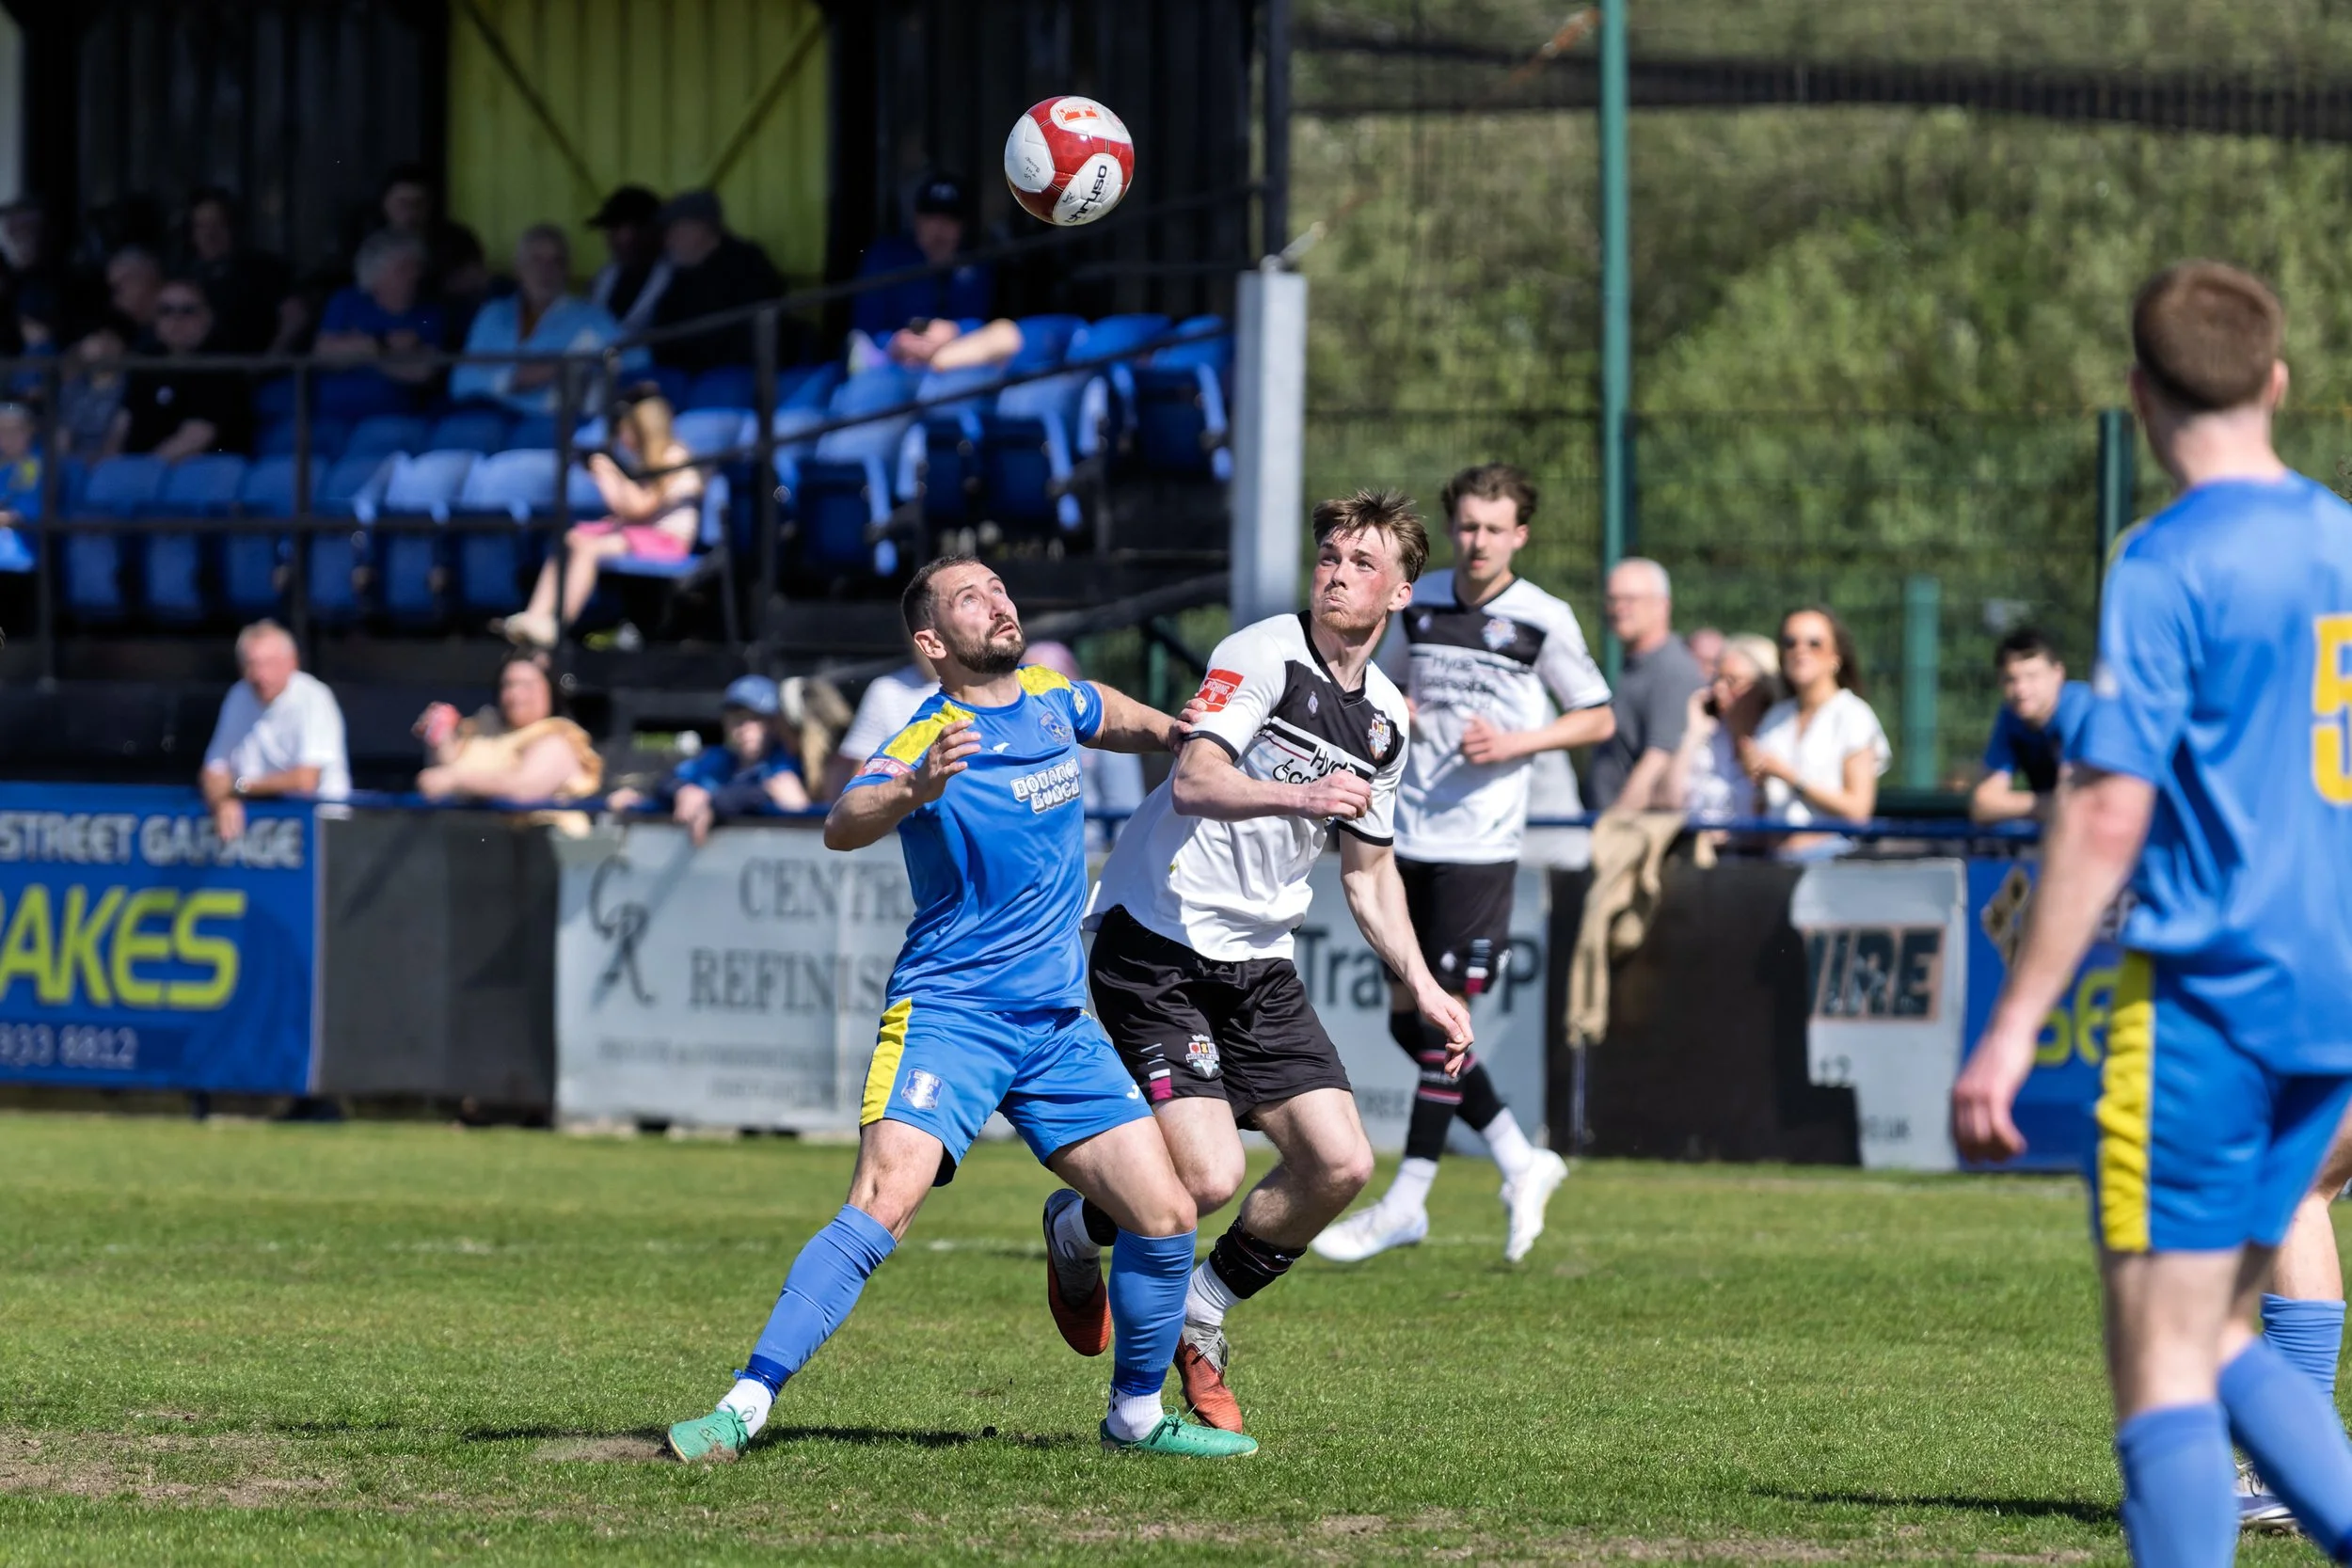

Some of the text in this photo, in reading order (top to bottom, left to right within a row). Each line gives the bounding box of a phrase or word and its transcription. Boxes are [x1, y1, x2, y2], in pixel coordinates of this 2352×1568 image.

[1310, 748, 1356, 777] Hyd
[0, 811, 138, 864] STREET
[739, 854, 916, 923] CENTR
[0, 882, 247, 1012] AKES
[690, 946, 890, 1018] REFINIS
[1295, 923, 1385, 1008] Tra
